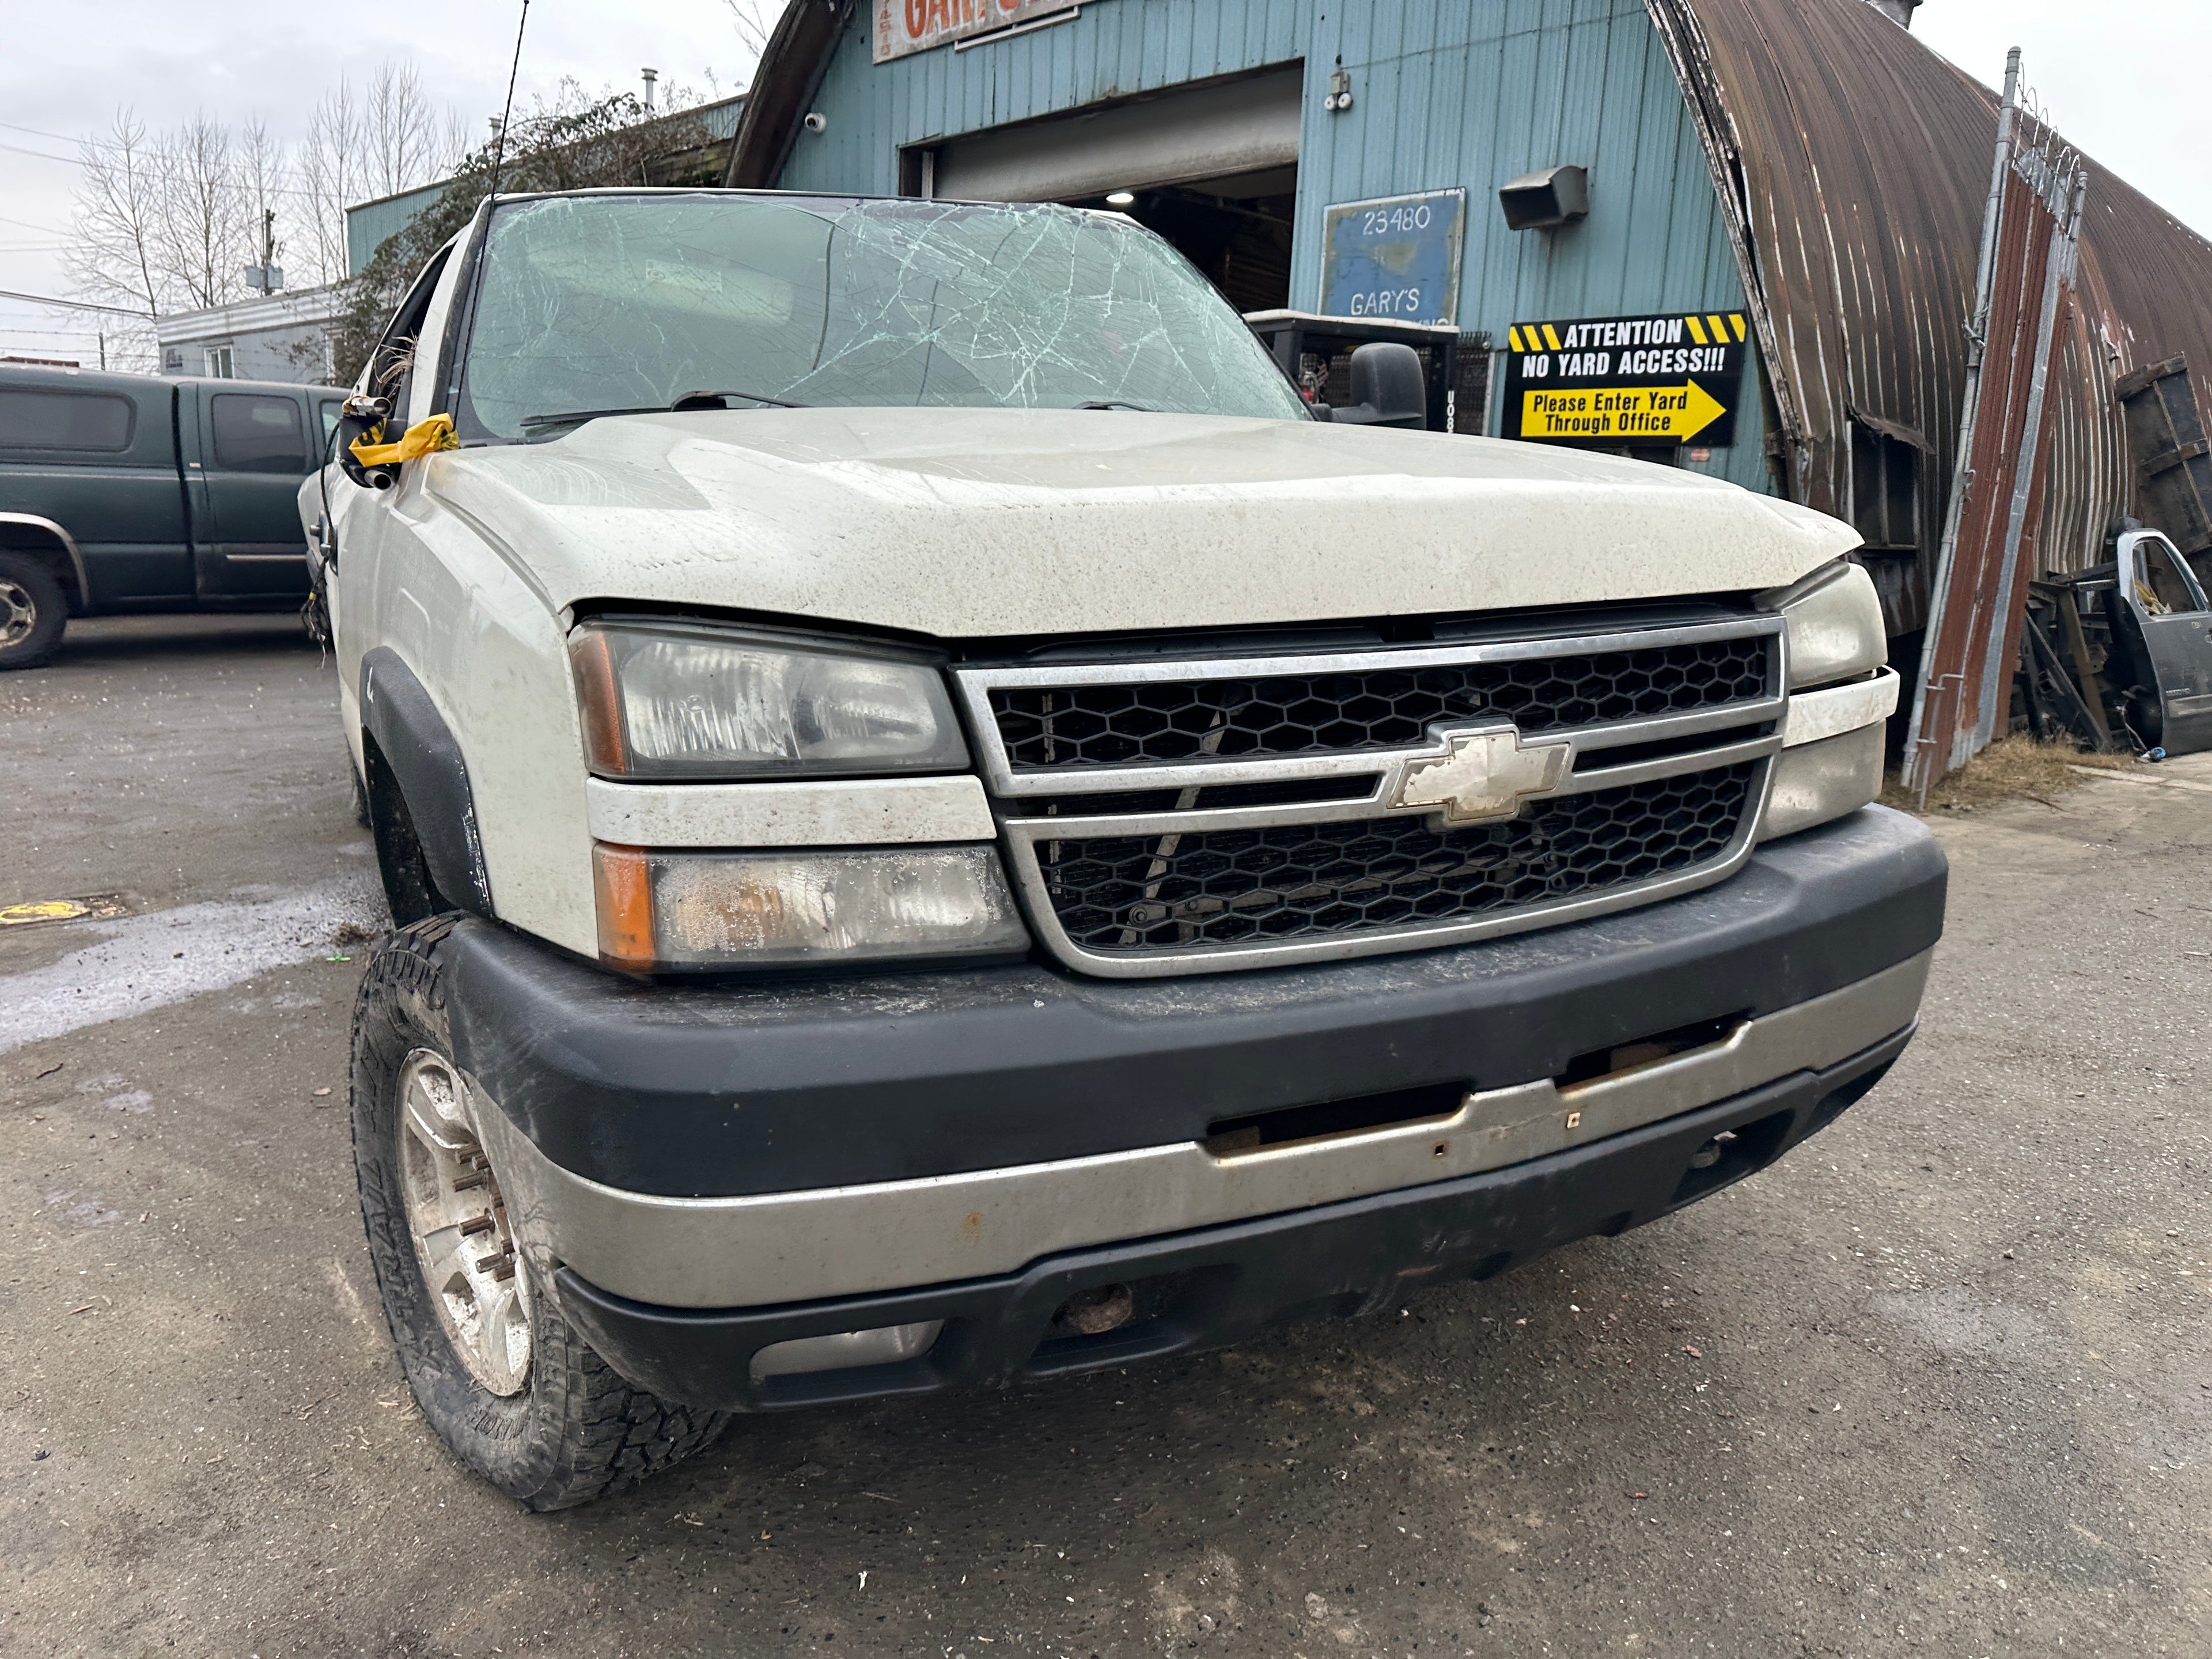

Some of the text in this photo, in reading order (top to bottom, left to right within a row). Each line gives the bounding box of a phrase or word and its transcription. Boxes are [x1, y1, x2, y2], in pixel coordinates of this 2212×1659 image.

[1363, 205, 1431, 235] 23480
[1351, 288, 1419, 316] GARY'S
[1563, 319, 1683, 348] ATTENTION
[1522, 347, 1725, 377] NO YARD ACCESS!!!
[1533, 391, 1688, 412] Please Enter Yard
[1546, 412, 1671, 434] Through Office
